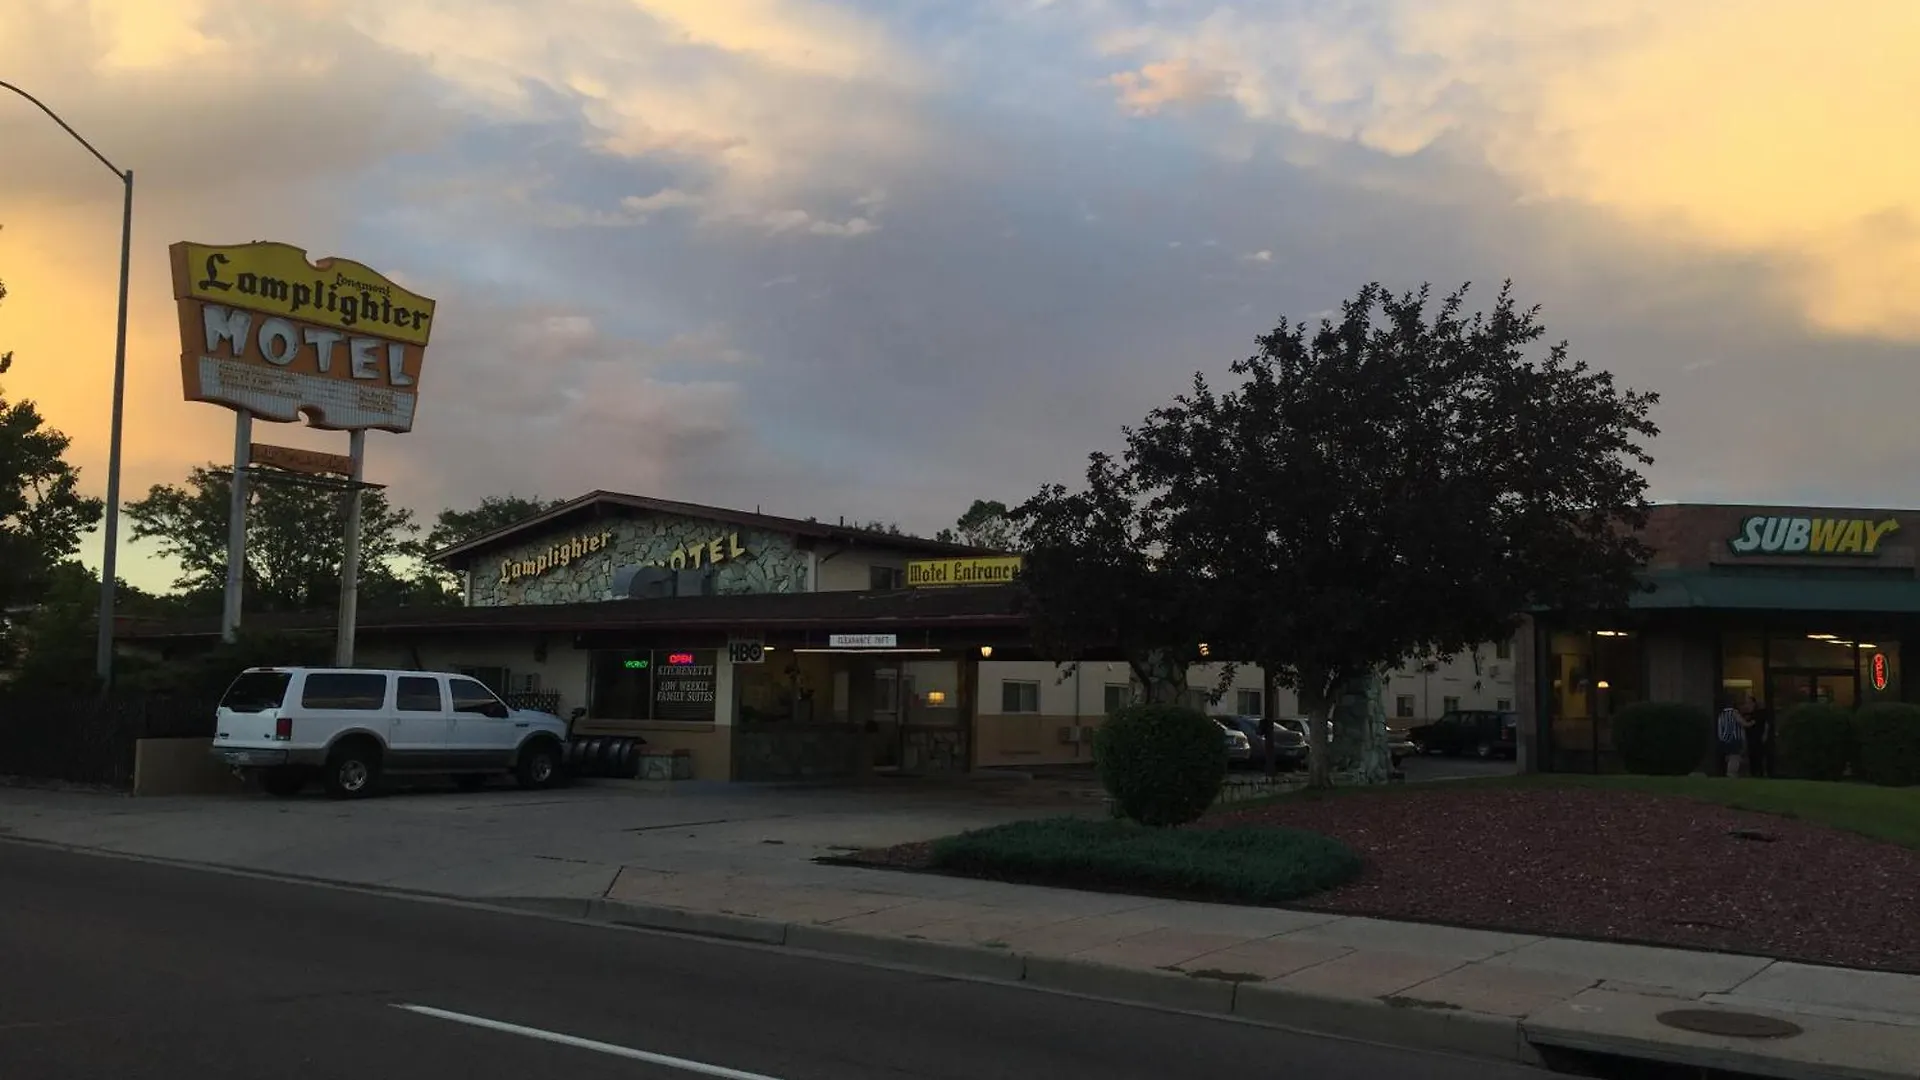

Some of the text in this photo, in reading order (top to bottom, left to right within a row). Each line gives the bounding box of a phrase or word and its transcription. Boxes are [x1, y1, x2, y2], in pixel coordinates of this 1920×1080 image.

[199, 253, 429, 331] Lamplighter
[203, 304, 413, 386] MOTEL
[652, 531, 746, 573] OTEL
[1733, 516, 1899, 553] SUBWAY
[500, 531, 612, 584] Lamplighter
[910, 562, 947, 582] Motel
[729, 642, 761, 662] HBO
